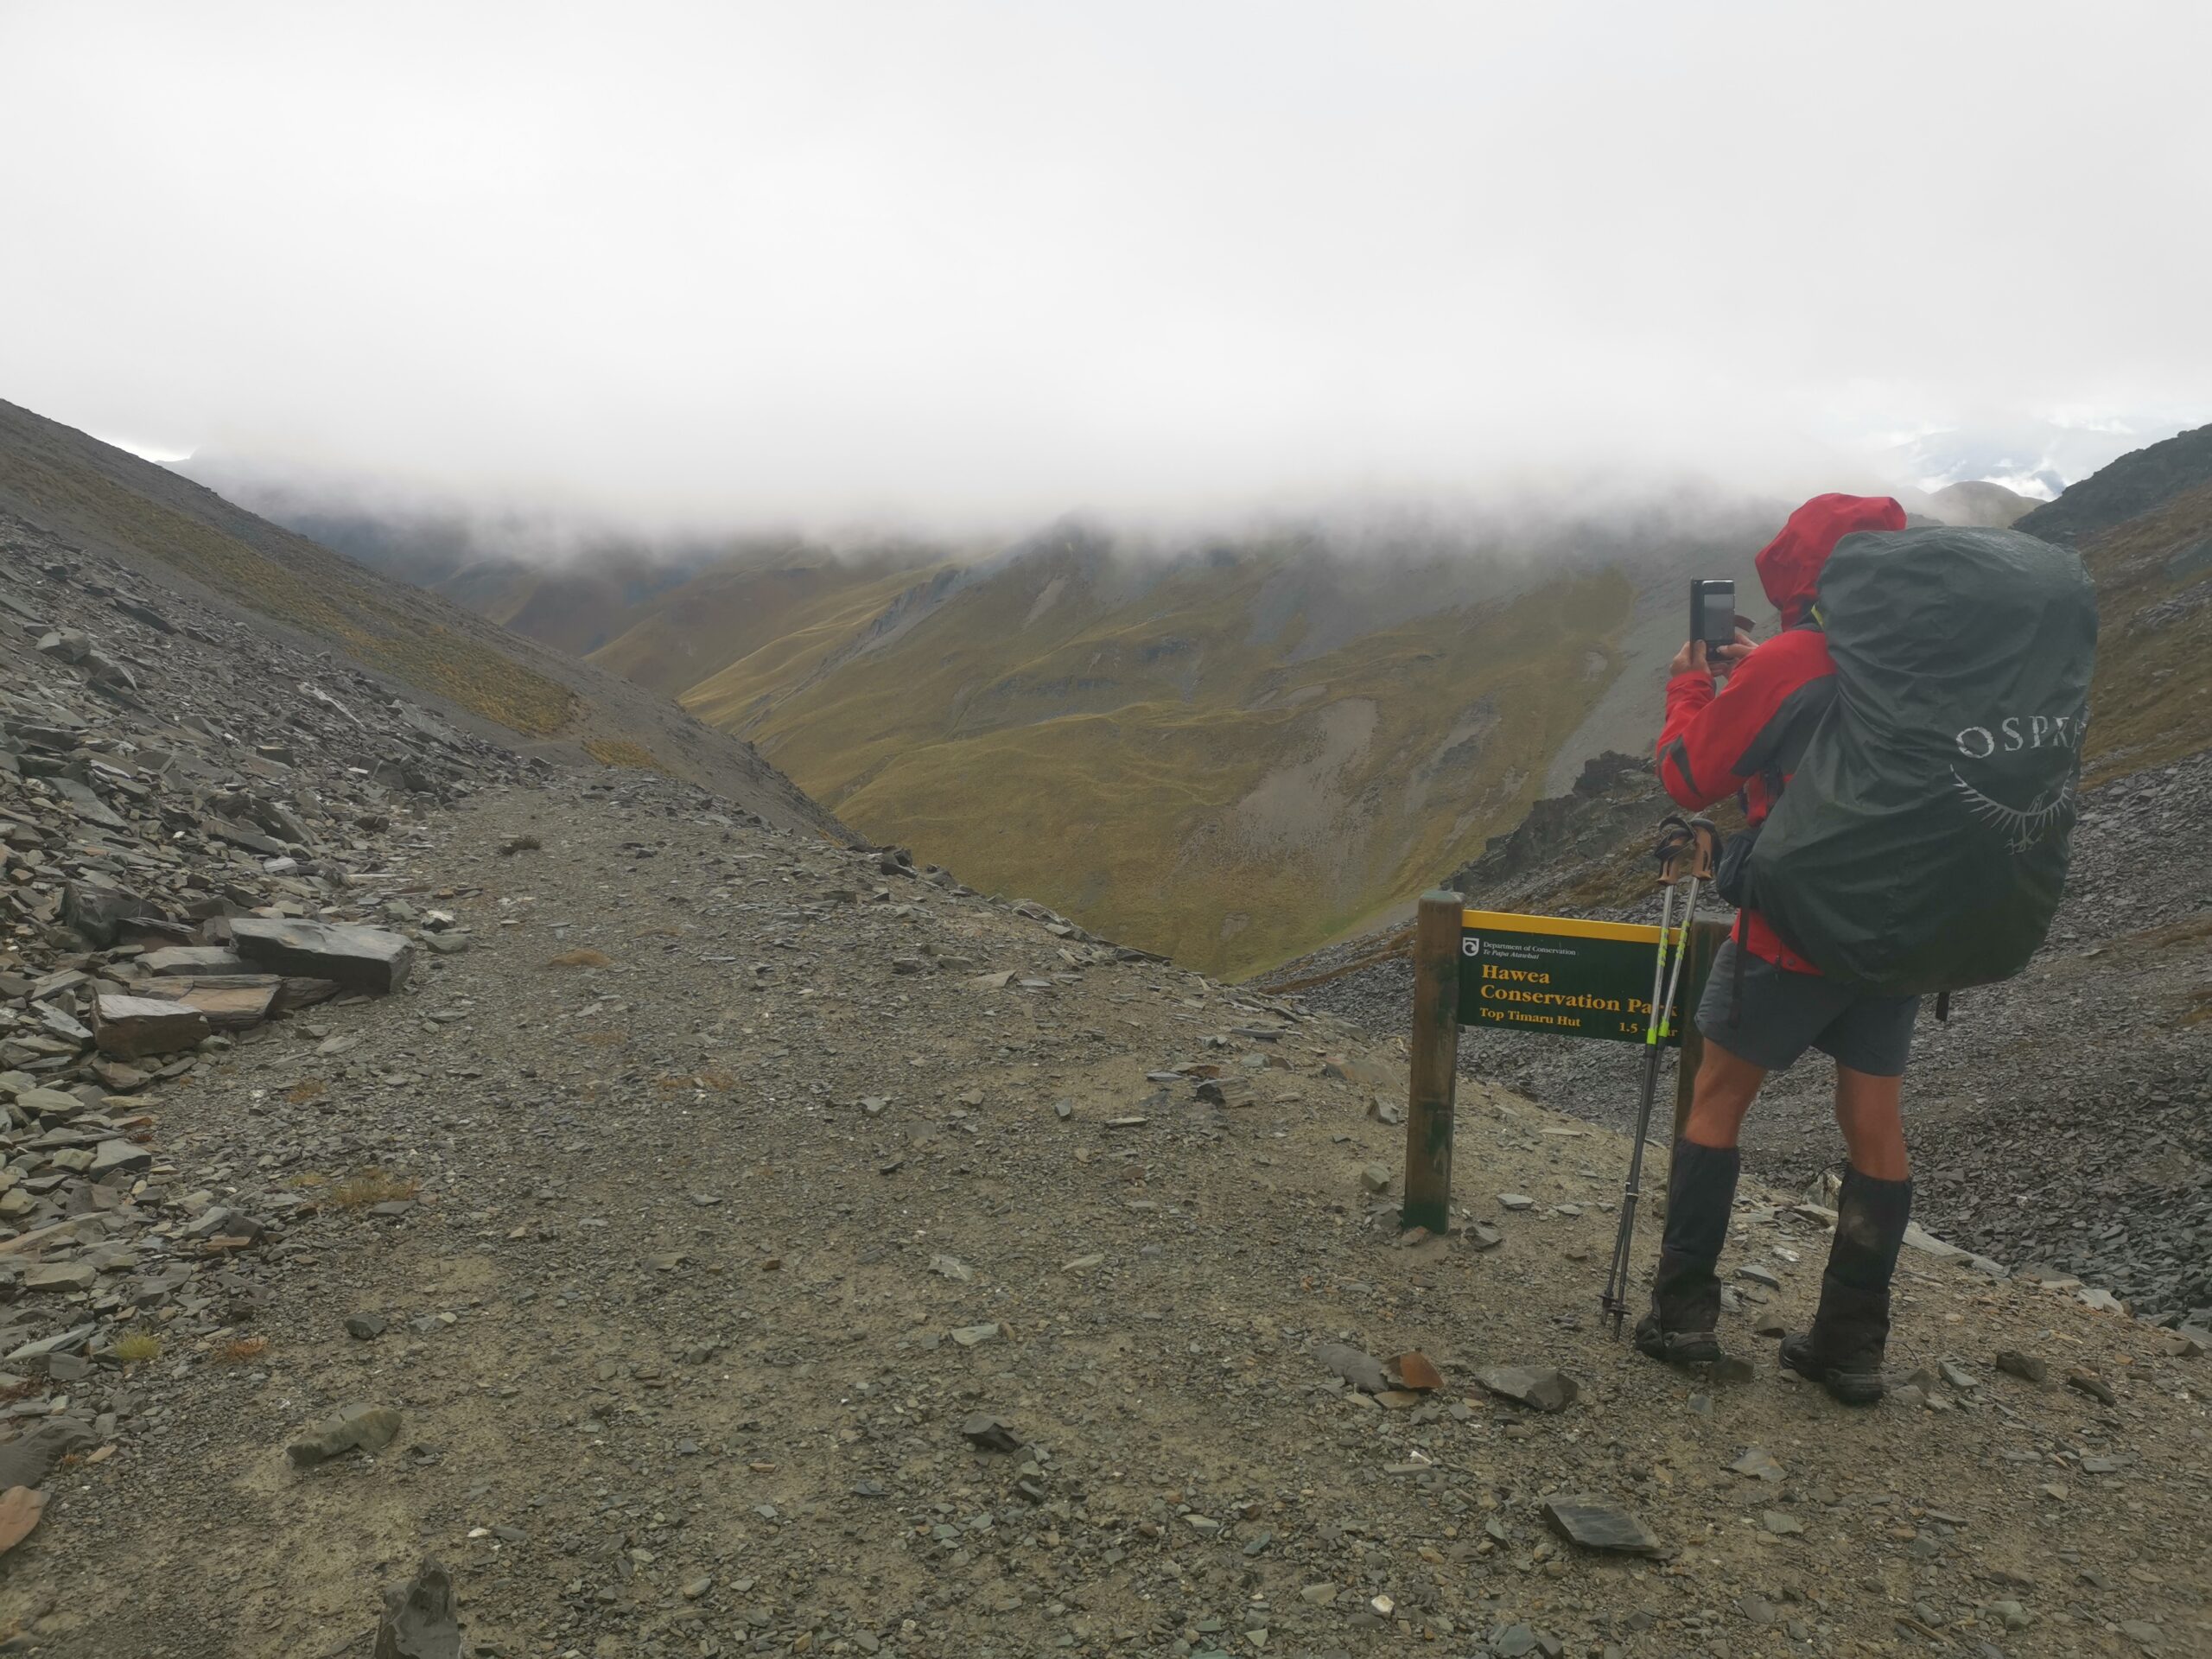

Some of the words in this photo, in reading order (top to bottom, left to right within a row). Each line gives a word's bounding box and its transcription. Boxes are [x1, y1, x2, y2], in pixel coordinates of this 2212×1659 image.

[1483, 941, 1522, 951] Department
[1532, 945, 1576, 956] Conservation
[1481, 964, 1550, 984] Hawea
[1480, 984, 1620, 1011] Conservation
[1479, 1007, 1504, 1020] Top
[1508, 1010, 1554, 1024] Timaru
[1557, 1015, 1581, 1027] Hut
[1619, 1022, 1638, 1033] 1.5
